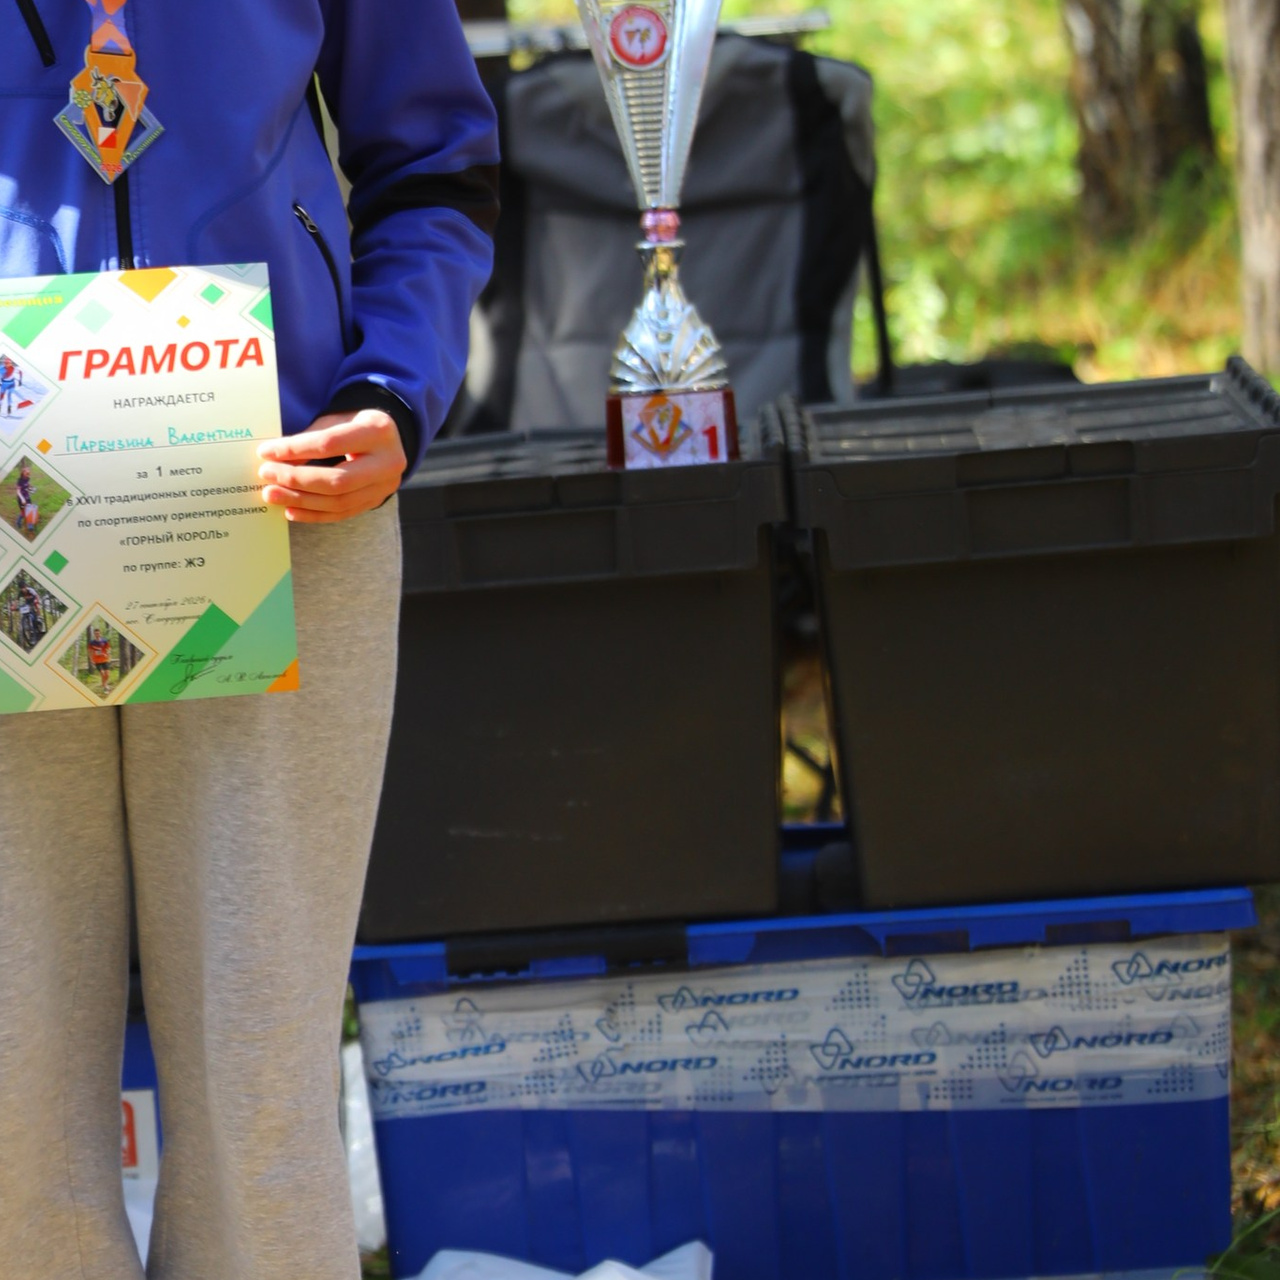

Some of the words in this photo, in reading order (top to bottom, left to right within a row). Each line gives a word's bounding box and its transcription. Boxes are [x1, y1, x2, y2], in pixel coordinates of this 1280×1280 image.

[58, 337, 265, 381] ГРАМОТА
[113, 391, 215, 409] НАГРАЖДАЕТСЯ
[702, 425, 719, 461] 1
[135, 471, 148, 479] за
[155, 466, 163, 477] 1
[170, 466, 202, 477] место
[75, 495, 102, 506] XXVI
[104, 489, 188, 506] традиционных
[190, 483, 268, 499] соревновани
[78, 519, 91, 528] по
[94, 513, 168, 528] спортивному
[171, 505, 268, 522] ориентированию
[119, 533, 174, 547] «ГОРНЫЙ
[177, 529, 230, 543] КОРОЛЬ»
[123, 564, 137, 573] по
[140, 560, 181, 573] группе:
[184, 557, 206, 569] ЖЭ
[1154, 952, 1228, 975] NOR
[700, 987, 800, 1007] NORD
[920, 981, 1018, 999] NORD
[1072, 1030, 1174, 1049] NORD
[406, 1041, 507, 1067] NORD
[838, 1052, 937, 1070] NORD
[620, 1056, 718, 1075] NORD
[390, 1080, 488, 1105] NORD
